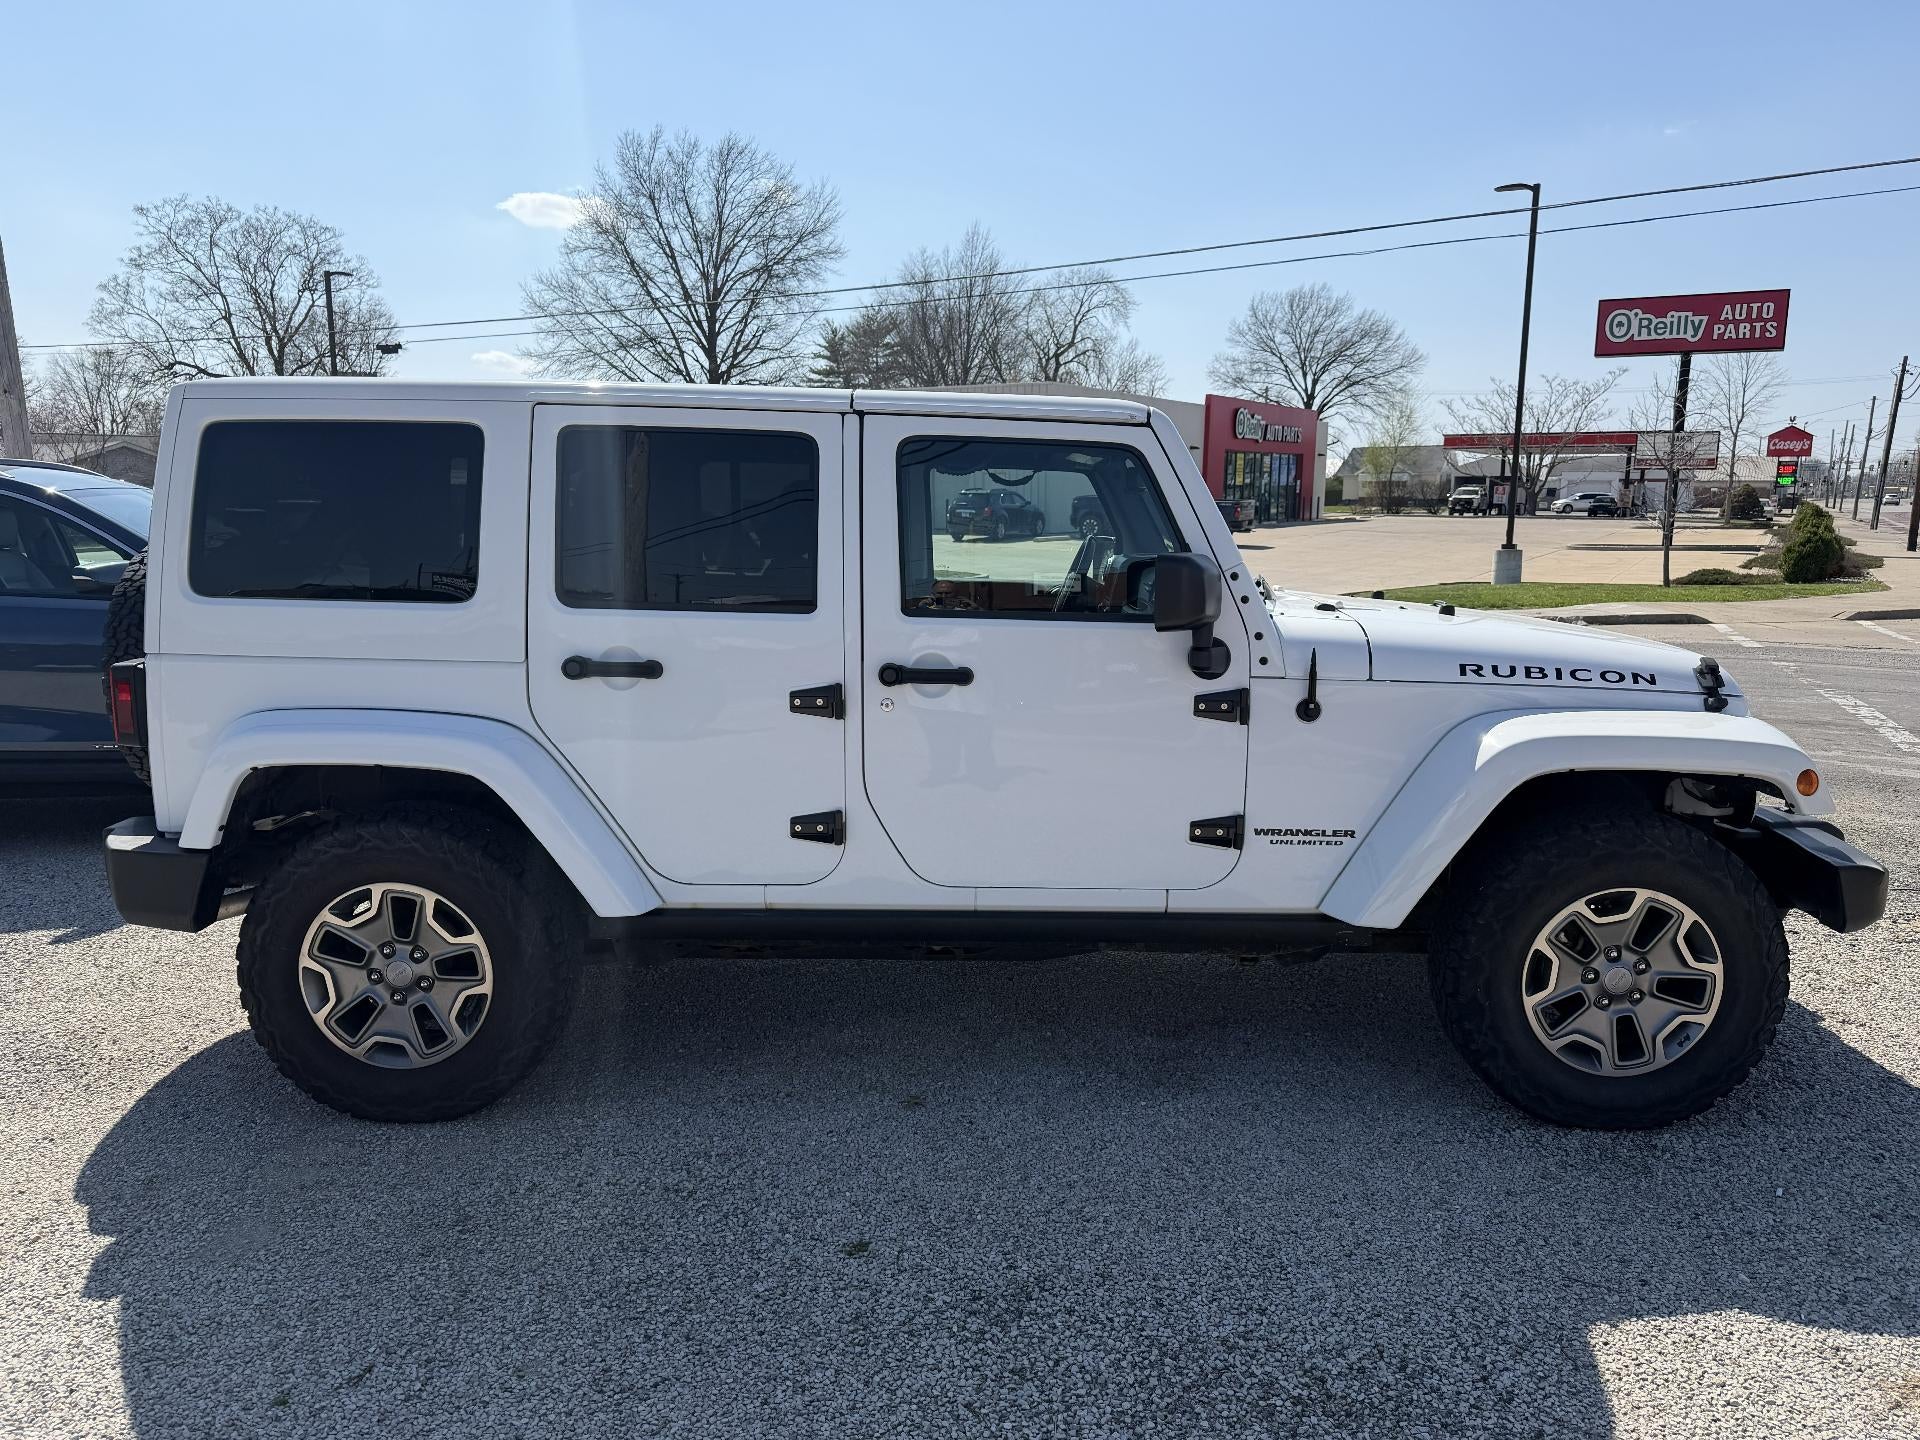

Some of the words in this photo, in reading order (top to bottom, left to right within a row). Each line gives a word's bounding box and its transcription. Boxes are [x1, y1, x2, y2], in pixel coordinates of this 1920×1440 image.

[1719, 301, 1775, 321] AUTO
[1606, 310, 1707, 341] O'Reilly
[1712, 321, 1778, 340] PARTS
[1266, 424, 1283, 441] AUTO
[1283, 426, 1302, 443] PARTS
[1769, 438, 1810, 452] Casey's
[1458, 663, 1657, 686] RUBICON
[1253, 827, 1357, 839] WRANGLER
